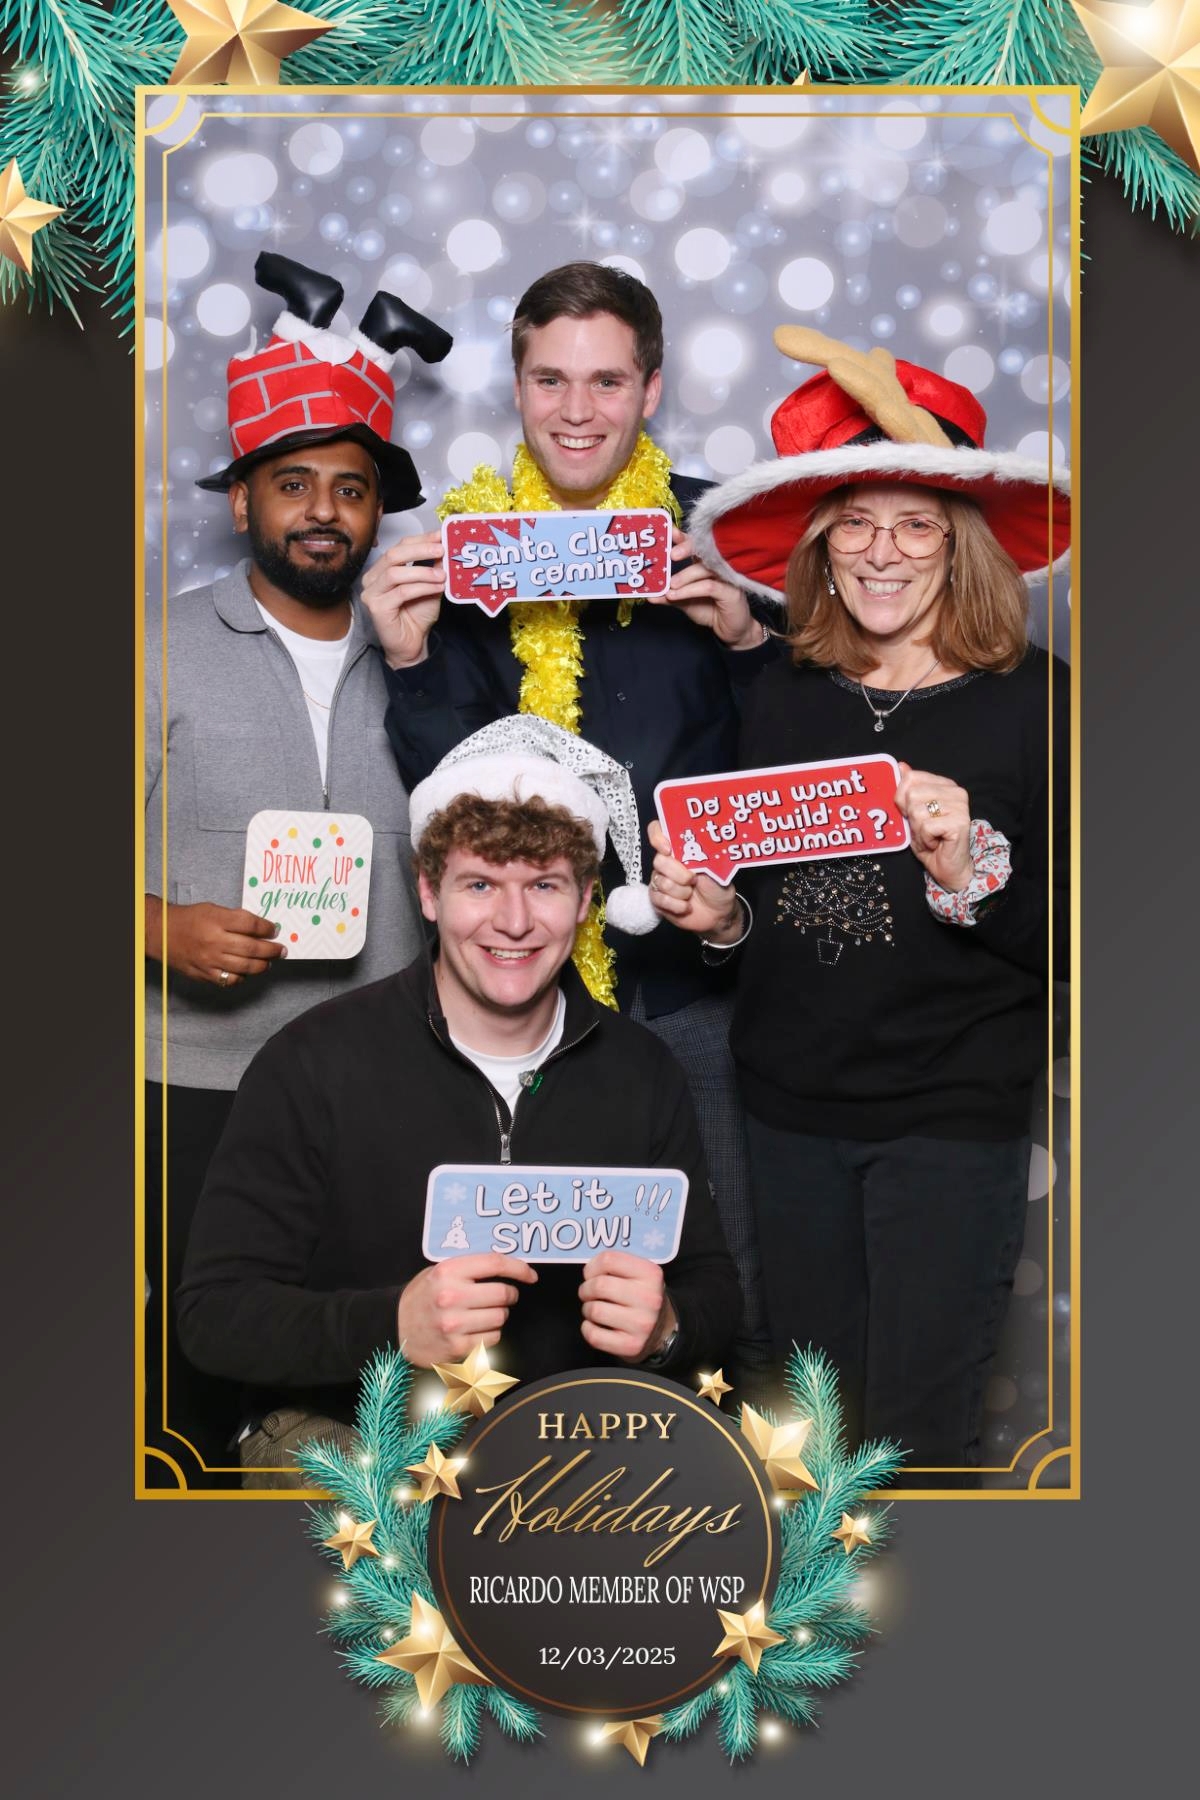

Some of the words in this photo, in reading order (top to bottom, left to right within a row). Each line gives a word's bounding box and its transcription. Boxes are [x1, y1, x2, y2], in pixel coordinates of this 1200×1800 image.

[460, 535, 558, 569] Santa
[569, 527, 656, 556] Claus
[490, 568, 517, 591] is
[530, 553, 645, 588] coming
[686, 796, 720, 818] Do
[729, 789, 782, 822] you
[791, 770, 867, 801] want
[706, 820, 736, 843] to
[759, 803, 829, 833] build
[839, 805, 858, 821] a
[728, 827, 864, 861] snowman
[868, 809, 888, 840] ?
[263, 850, 318, 884] DRINK
[334, 856, 353, 885] UP
[257, 877, 348, 918] grinches
[475, 1181, 560, 1217] Let
[572, 1178, 613, 1212] it
